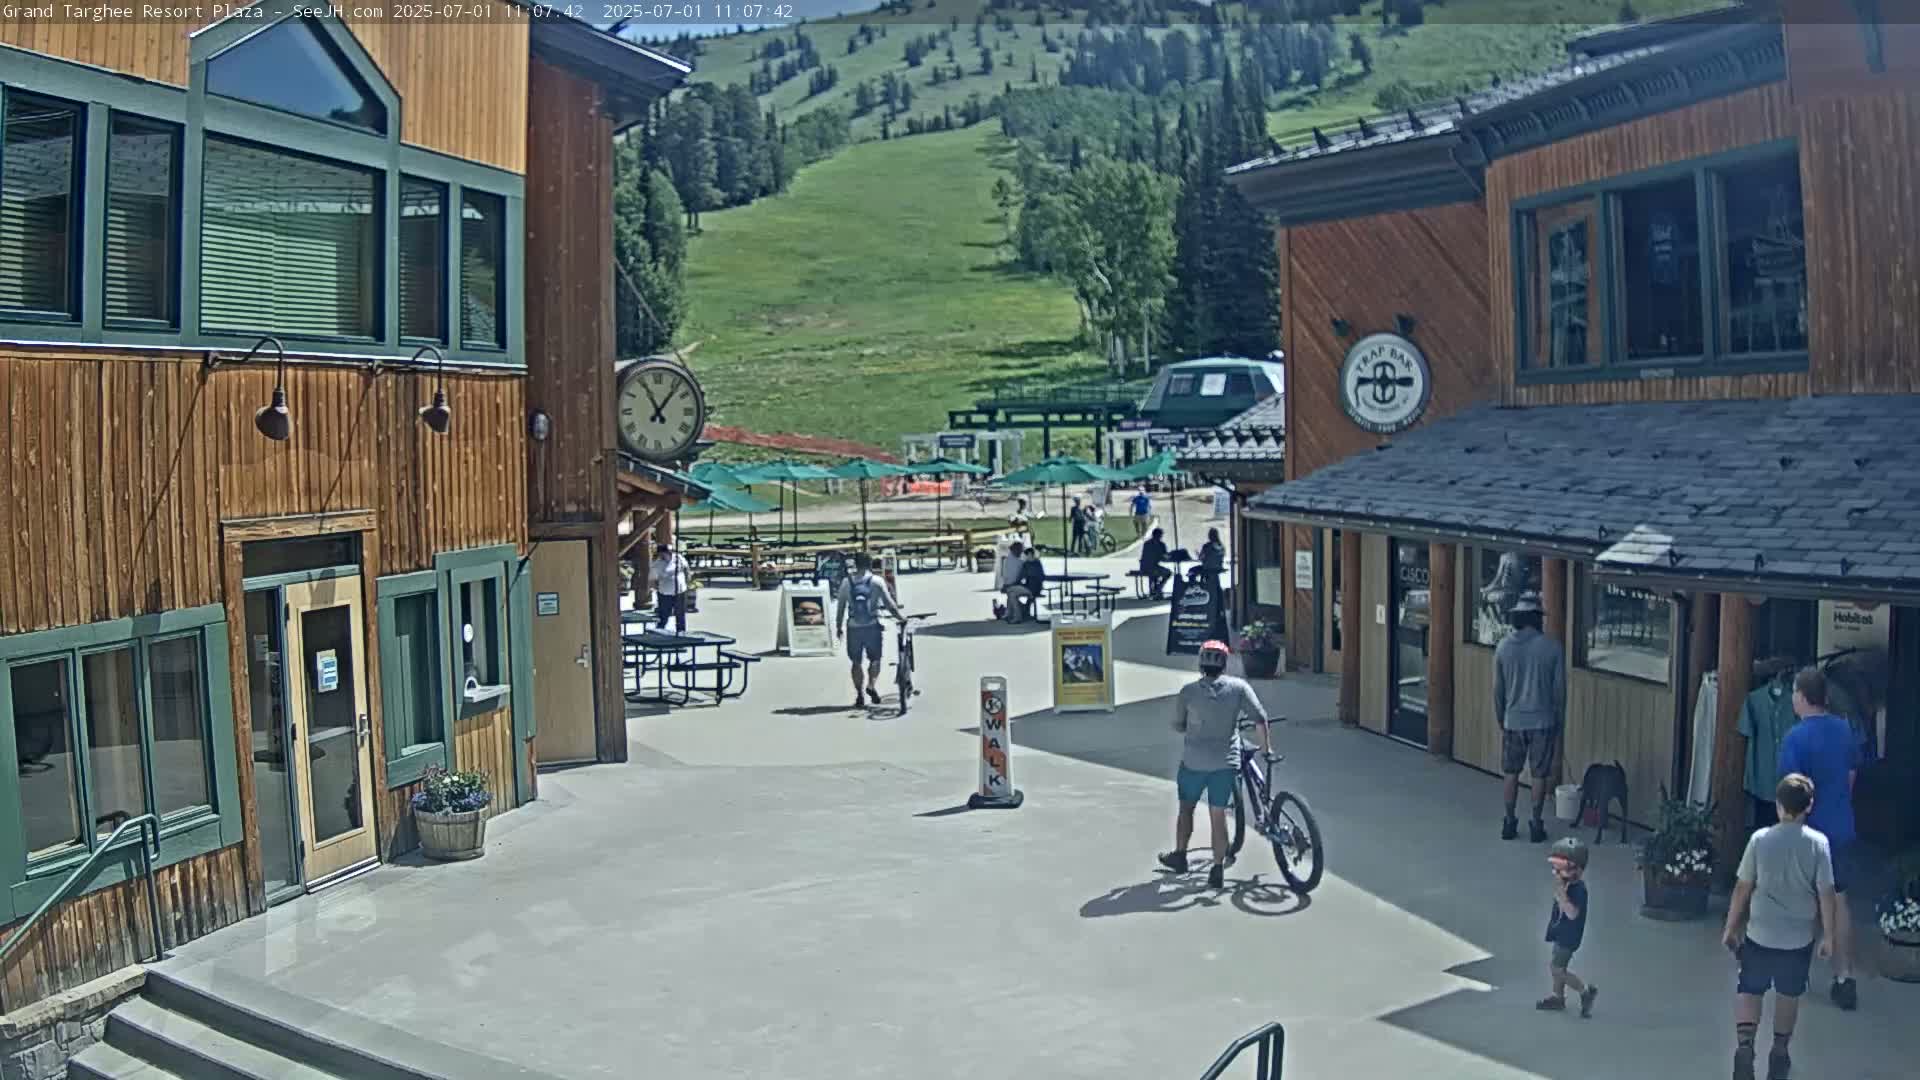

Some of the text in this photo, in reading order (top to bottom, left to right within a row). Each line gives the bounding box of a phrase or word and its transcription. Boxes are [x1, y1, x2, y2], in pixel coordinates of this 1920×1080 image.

[1356, 346, 1413, 373] TRAP BAR
[1833, 611, 1874, 625] Habitat
[985, 719, 1002, 786] WALK
